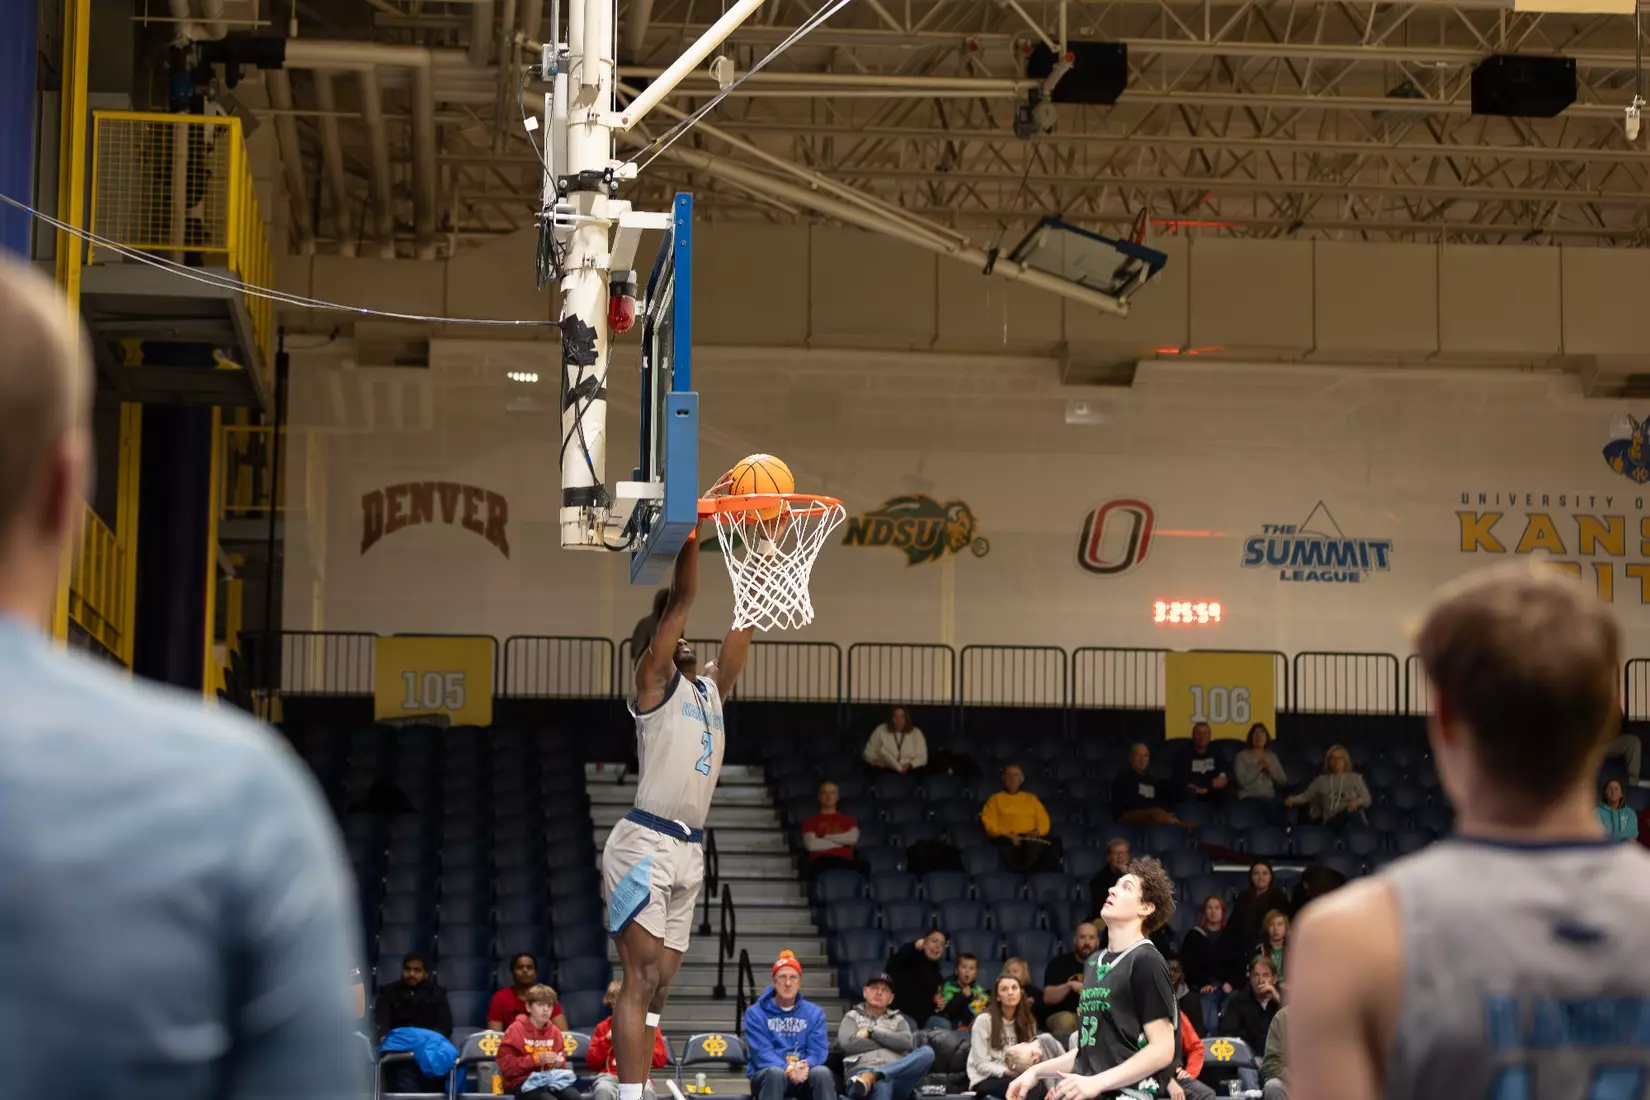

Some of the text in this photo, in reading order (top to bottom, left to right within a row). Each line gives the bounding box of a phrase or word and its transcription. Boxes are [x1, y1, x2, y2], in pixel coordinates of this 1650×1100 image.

[1461, 492, 1613, 508] UNIVERSITY
[361, 481, 510, 560] DENVER
[842, 517, 942, 549] NDSU
[1262, 524, 1297, 535] THE
[1454, 510, 1650, 557] KAN
[1244, 537, 1391, 570] SUMMIT
[1280, 569, 1361, 583] LEAGUE
[402, 671, 467, 710] 105
[1189, 684, 1251, 724] 106
[695, 731, 714, 776] 2
